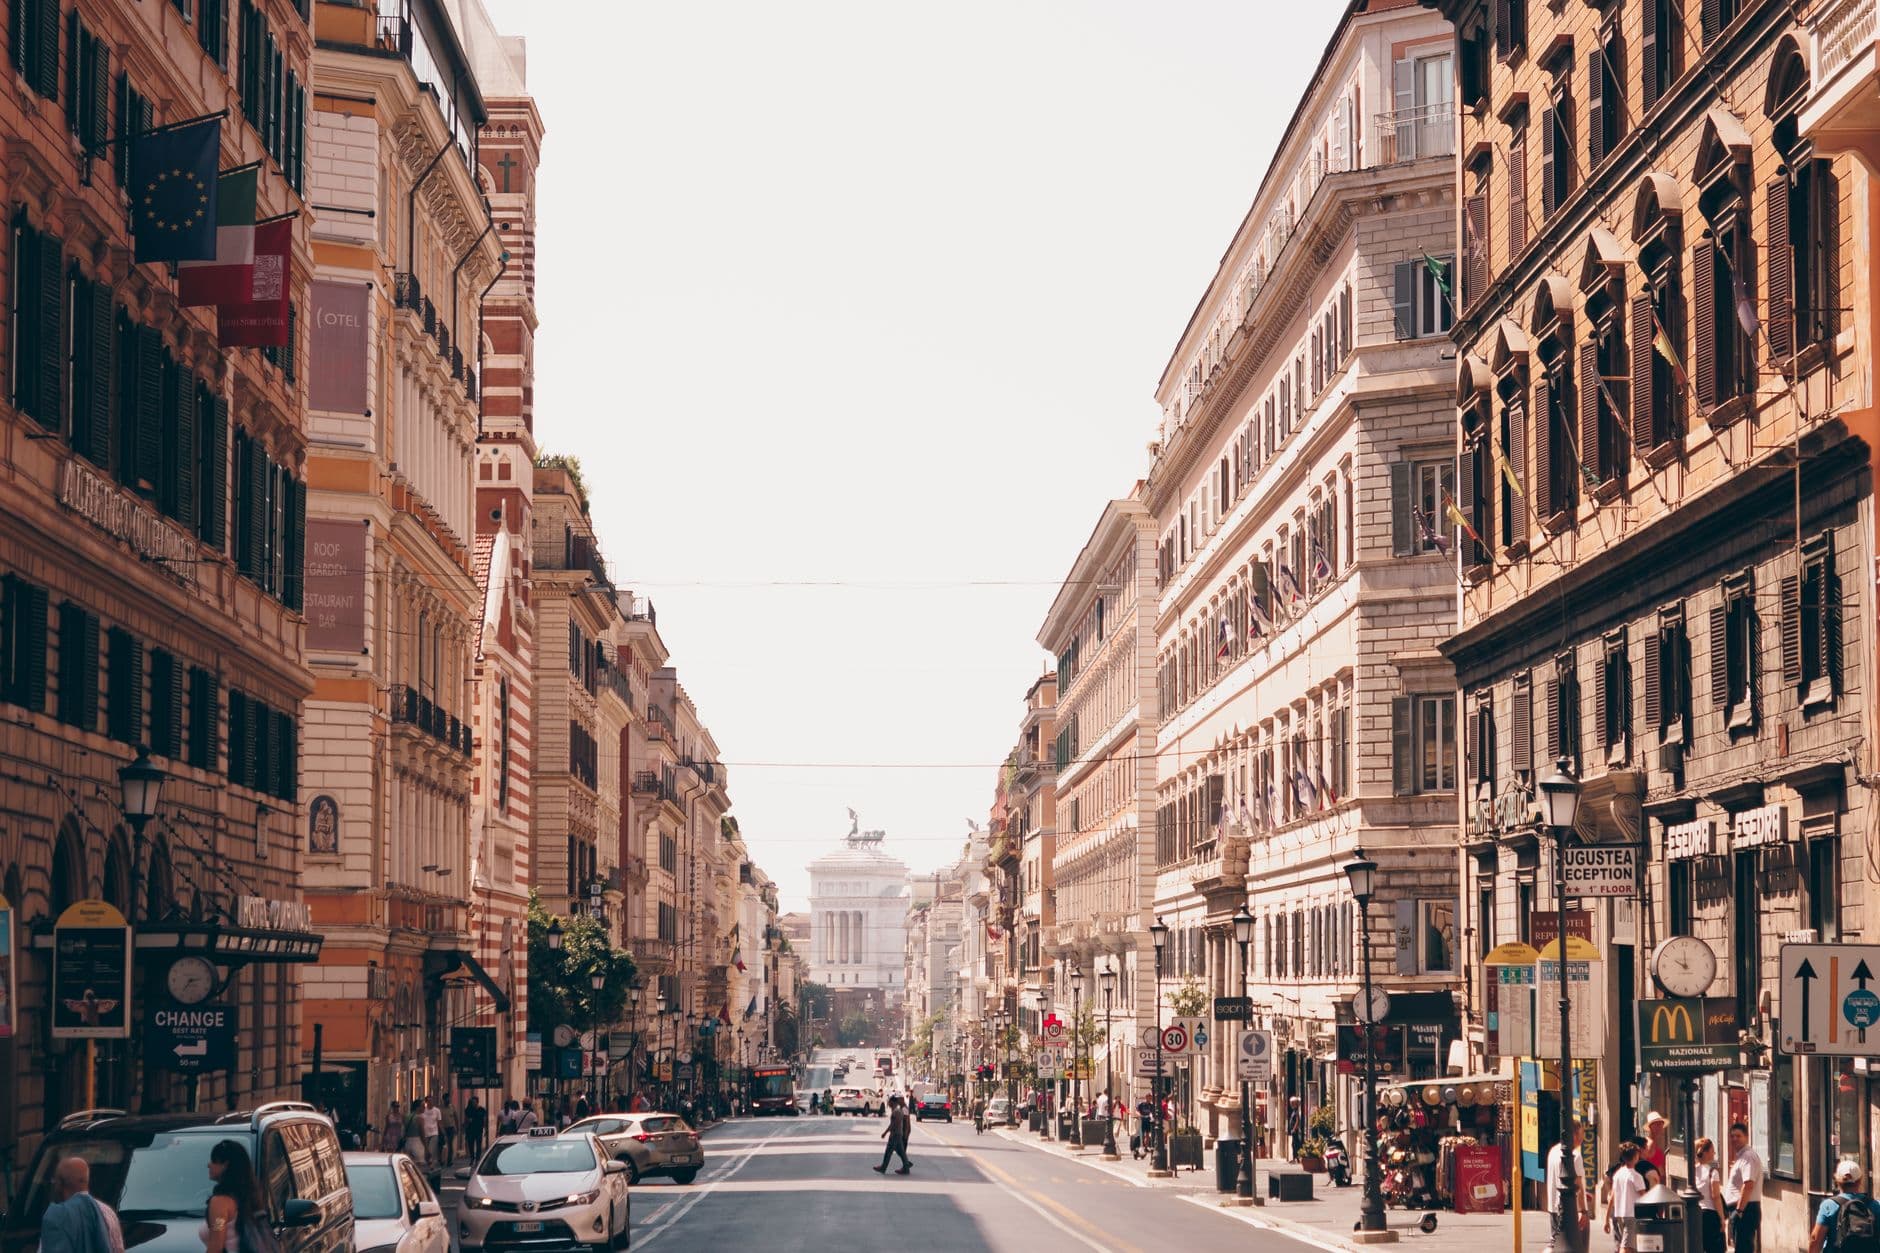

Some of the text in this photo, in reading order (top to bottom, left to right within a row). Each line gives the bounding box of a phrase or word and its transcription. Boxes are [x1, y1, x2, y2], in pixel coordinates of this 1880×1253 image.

[314, 543, 341, 557] ROOF
[309, 562, 347, 576] GARDEN
[304, 593, 354, 609] ESTAURANT
[319, 614, 336, 628] BAR
[1556, 850, 1633, 866] UGUSTEA
[1556, 868, 1633, 880] ECEPTION
[1600, 885, 1632, 893] FLOOR
[155, 1011, 224, 1027] CHANGE
[1167, 1033, 1182, 1046] 30
[1669, 1047, 1713, 1056] NAZIONALE
[1664, 1058, 1701, 1067] Nazionale
[533, 1128, 552, 1136] TAXI
